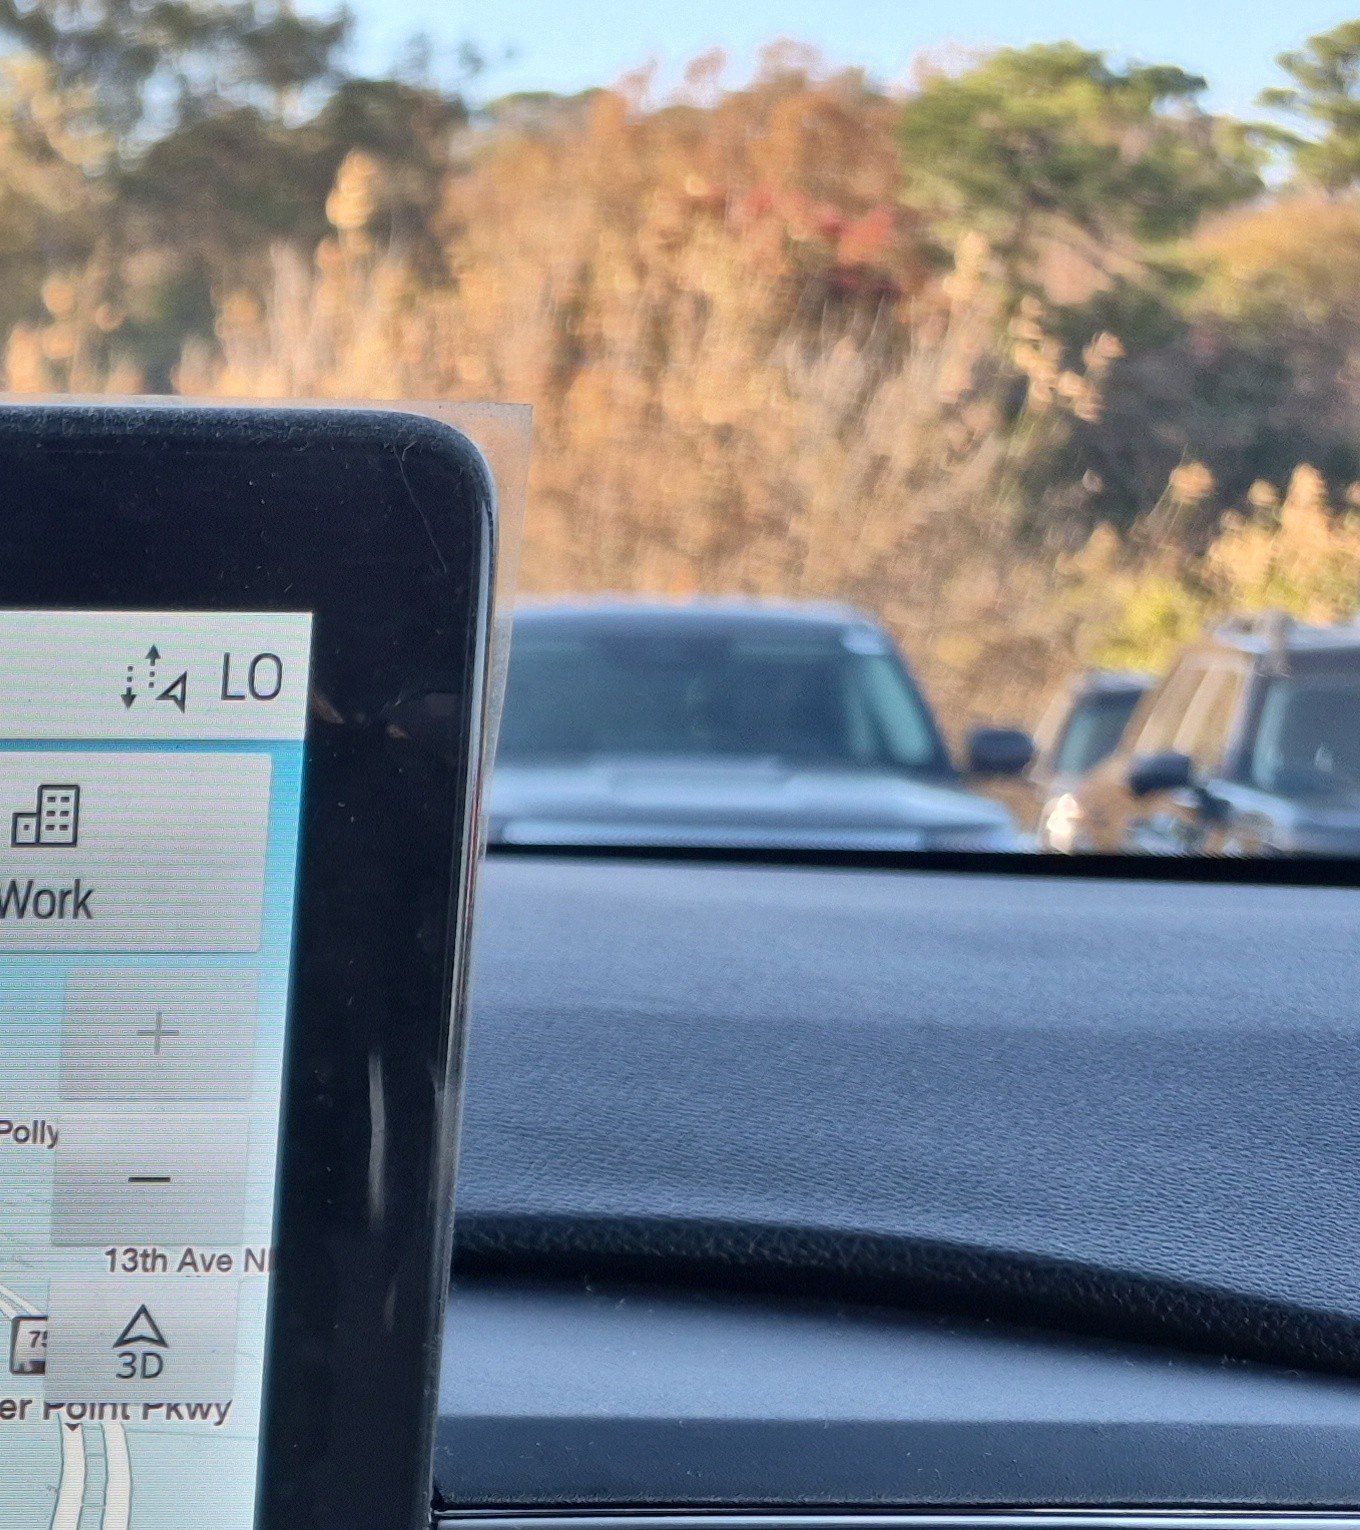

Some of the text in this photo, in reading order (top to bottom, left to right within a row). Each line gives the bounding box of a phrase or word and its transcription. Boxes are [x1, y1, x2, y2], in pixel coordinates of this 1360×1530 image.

[220, 651, 284, 702] LO
[103, 1247, 277, 1273] 13th Ave N
[115, 1351, 164, 1380] 3D
